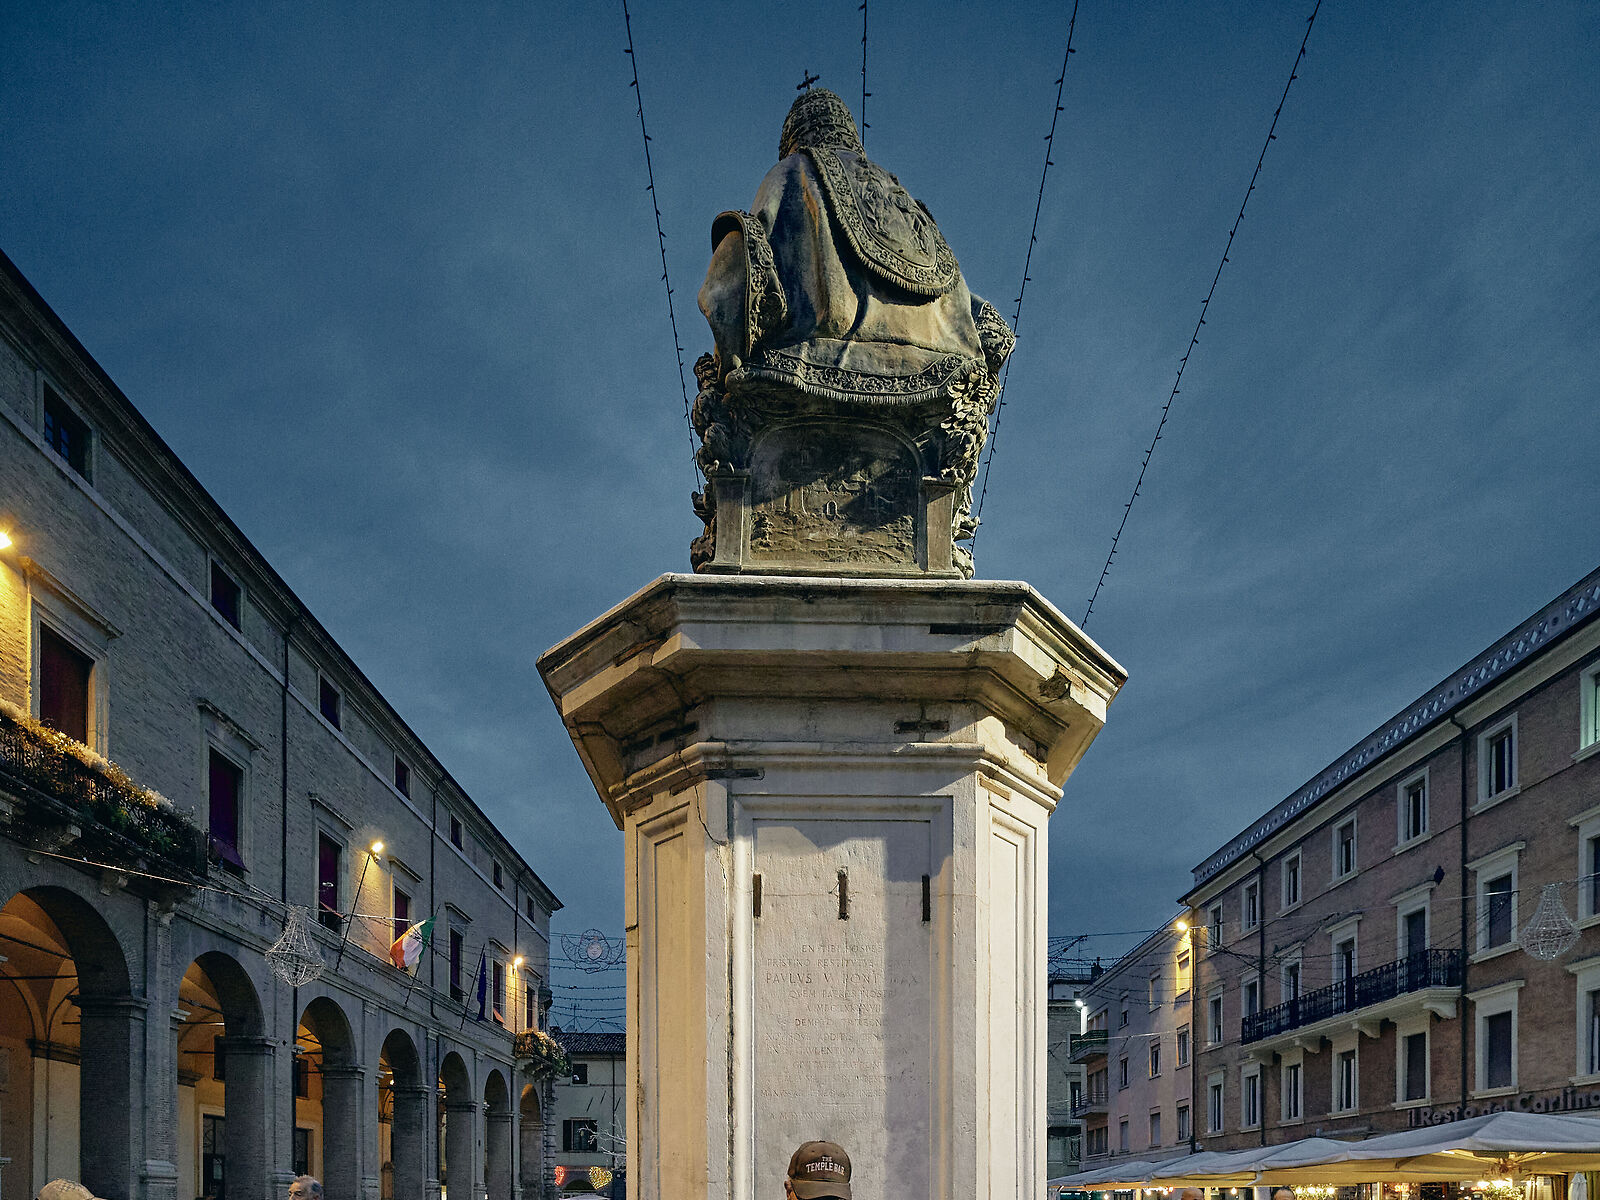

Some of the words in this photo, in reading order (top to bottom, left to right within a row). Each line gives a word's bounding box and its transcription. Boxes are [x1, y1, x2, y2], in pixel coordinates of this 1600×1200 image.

[1420, 1106, 1476, 1127] Resto
[1516, 1088, 1600, 1114] Carlino
[806, 1161, 834, 1173] TEMPLE
[834, 1163, 845, 1176] BAR
